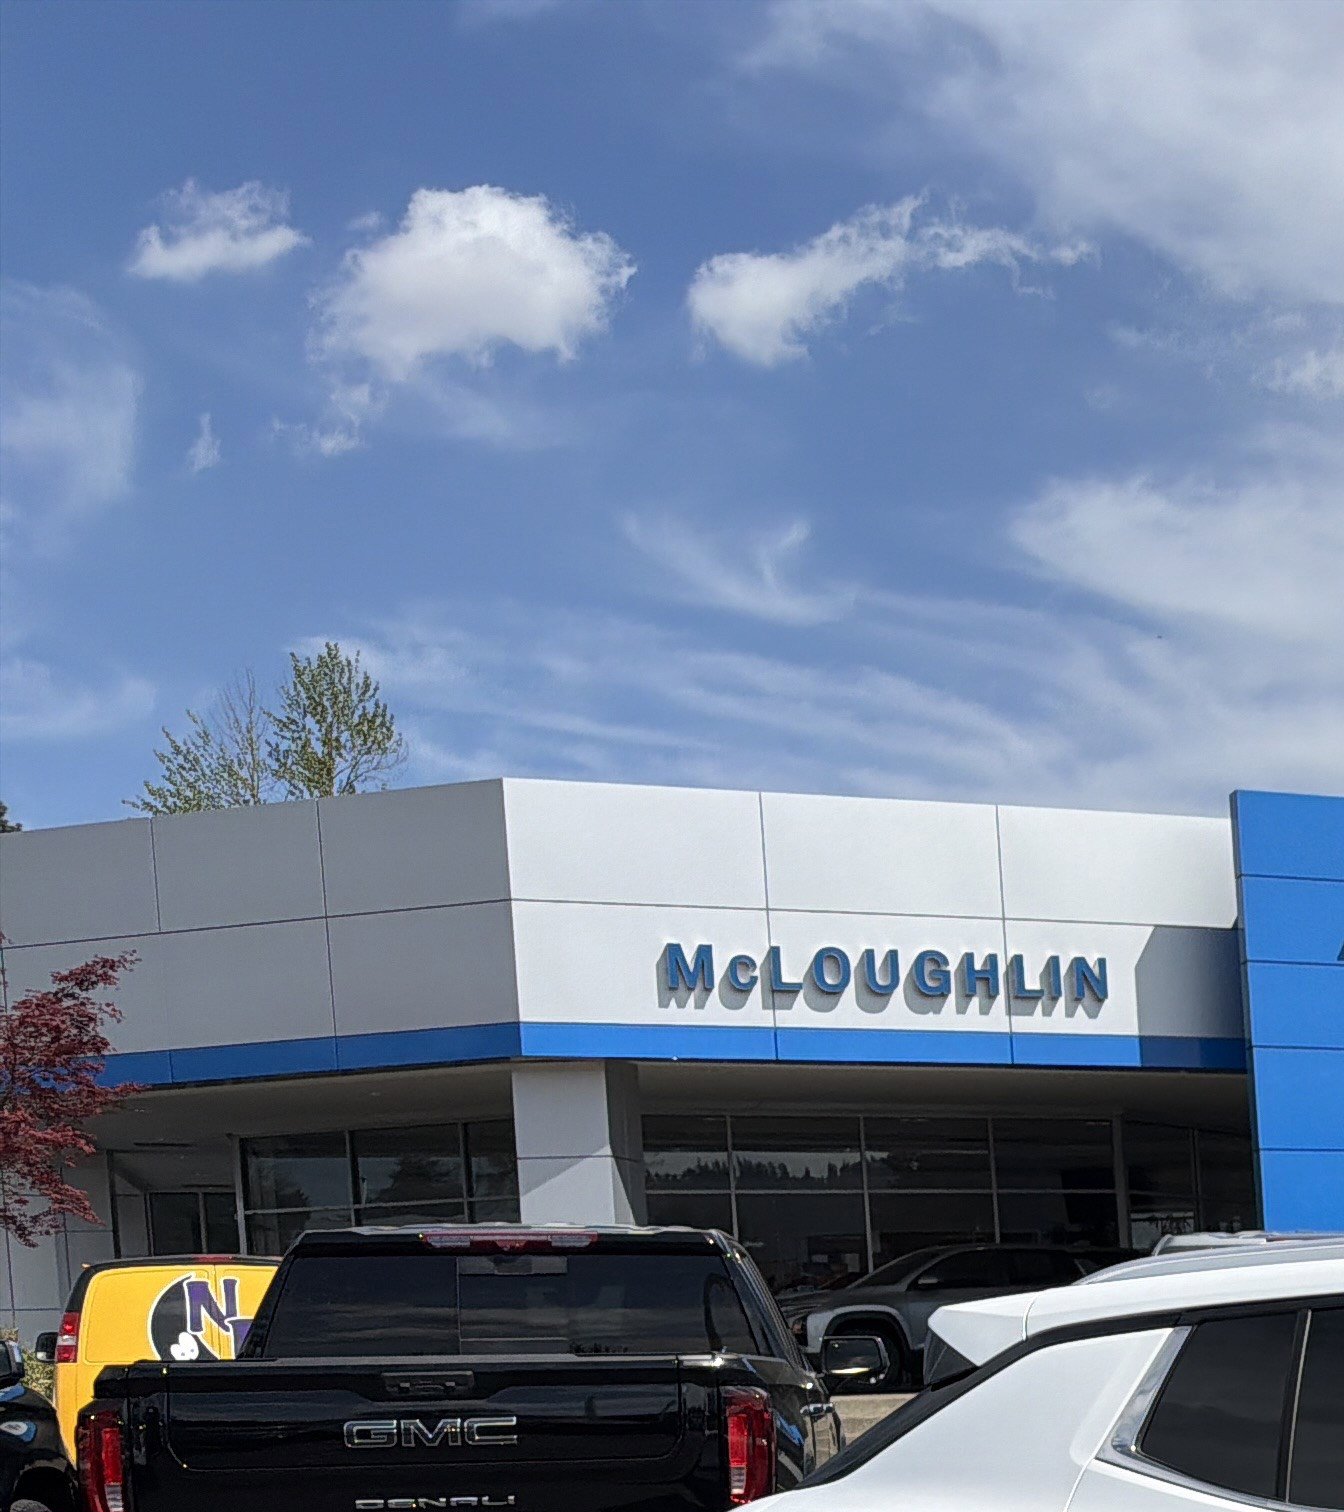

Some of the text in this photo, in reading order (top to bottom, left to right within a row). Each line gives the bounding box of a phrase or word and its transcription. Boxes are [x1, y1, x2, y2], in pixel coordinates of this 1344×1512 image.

[664, 941, 1110, 1001] McLOUGHLIN
[343, 1416, 518, 1448] GMC
[355, 1495, 515, 1510] DENALI
